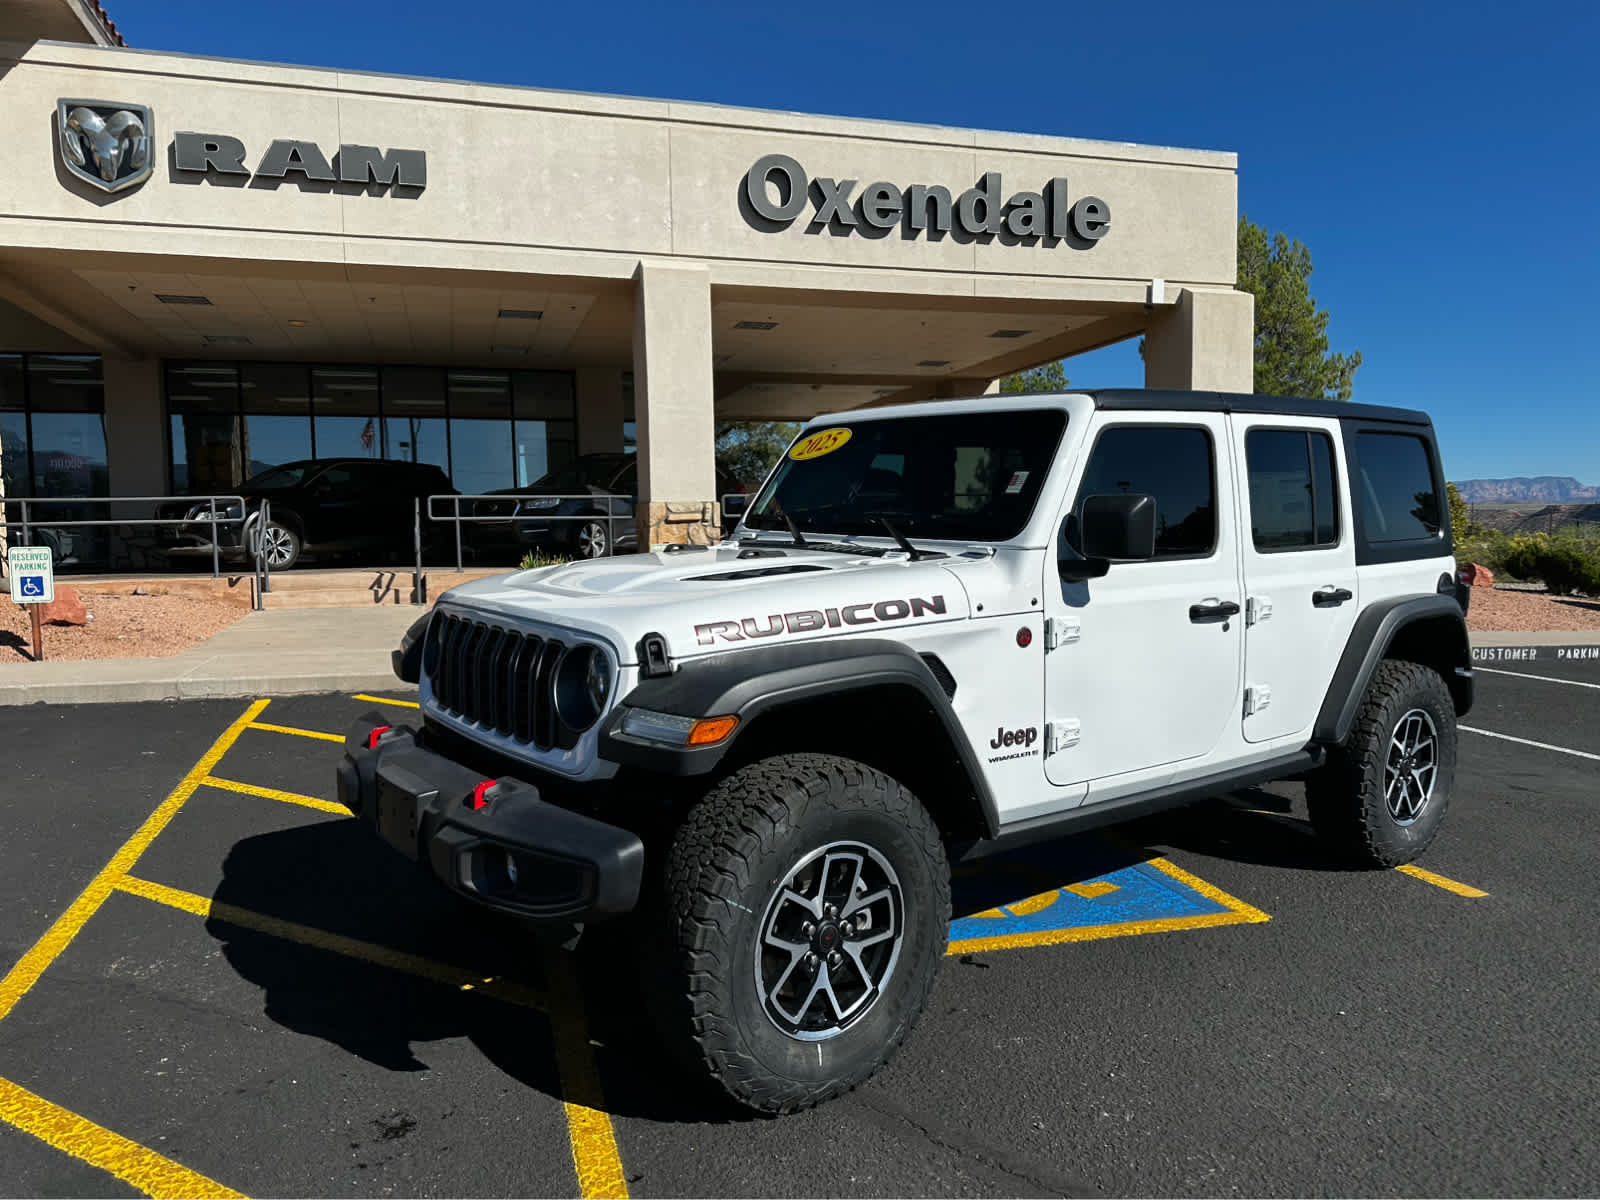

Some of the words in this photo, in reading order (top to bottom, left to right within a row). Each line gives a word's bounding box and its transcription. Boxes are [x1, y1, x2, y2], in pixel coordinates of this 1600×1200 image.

[174, 131, 427, 189] RAM
[745, 153, 1112, 241] Oxendale
[796, 431, 844, 457] 2025
[11, 553, 49, 561] RESERVED
[693, 595, 947, 646] RUBICON
[1472, 648, 1537, 661] CUSTOMER
[990, 726, 1038, 750] Jeep
[988, 751, 1031, 764] WRANGLER
